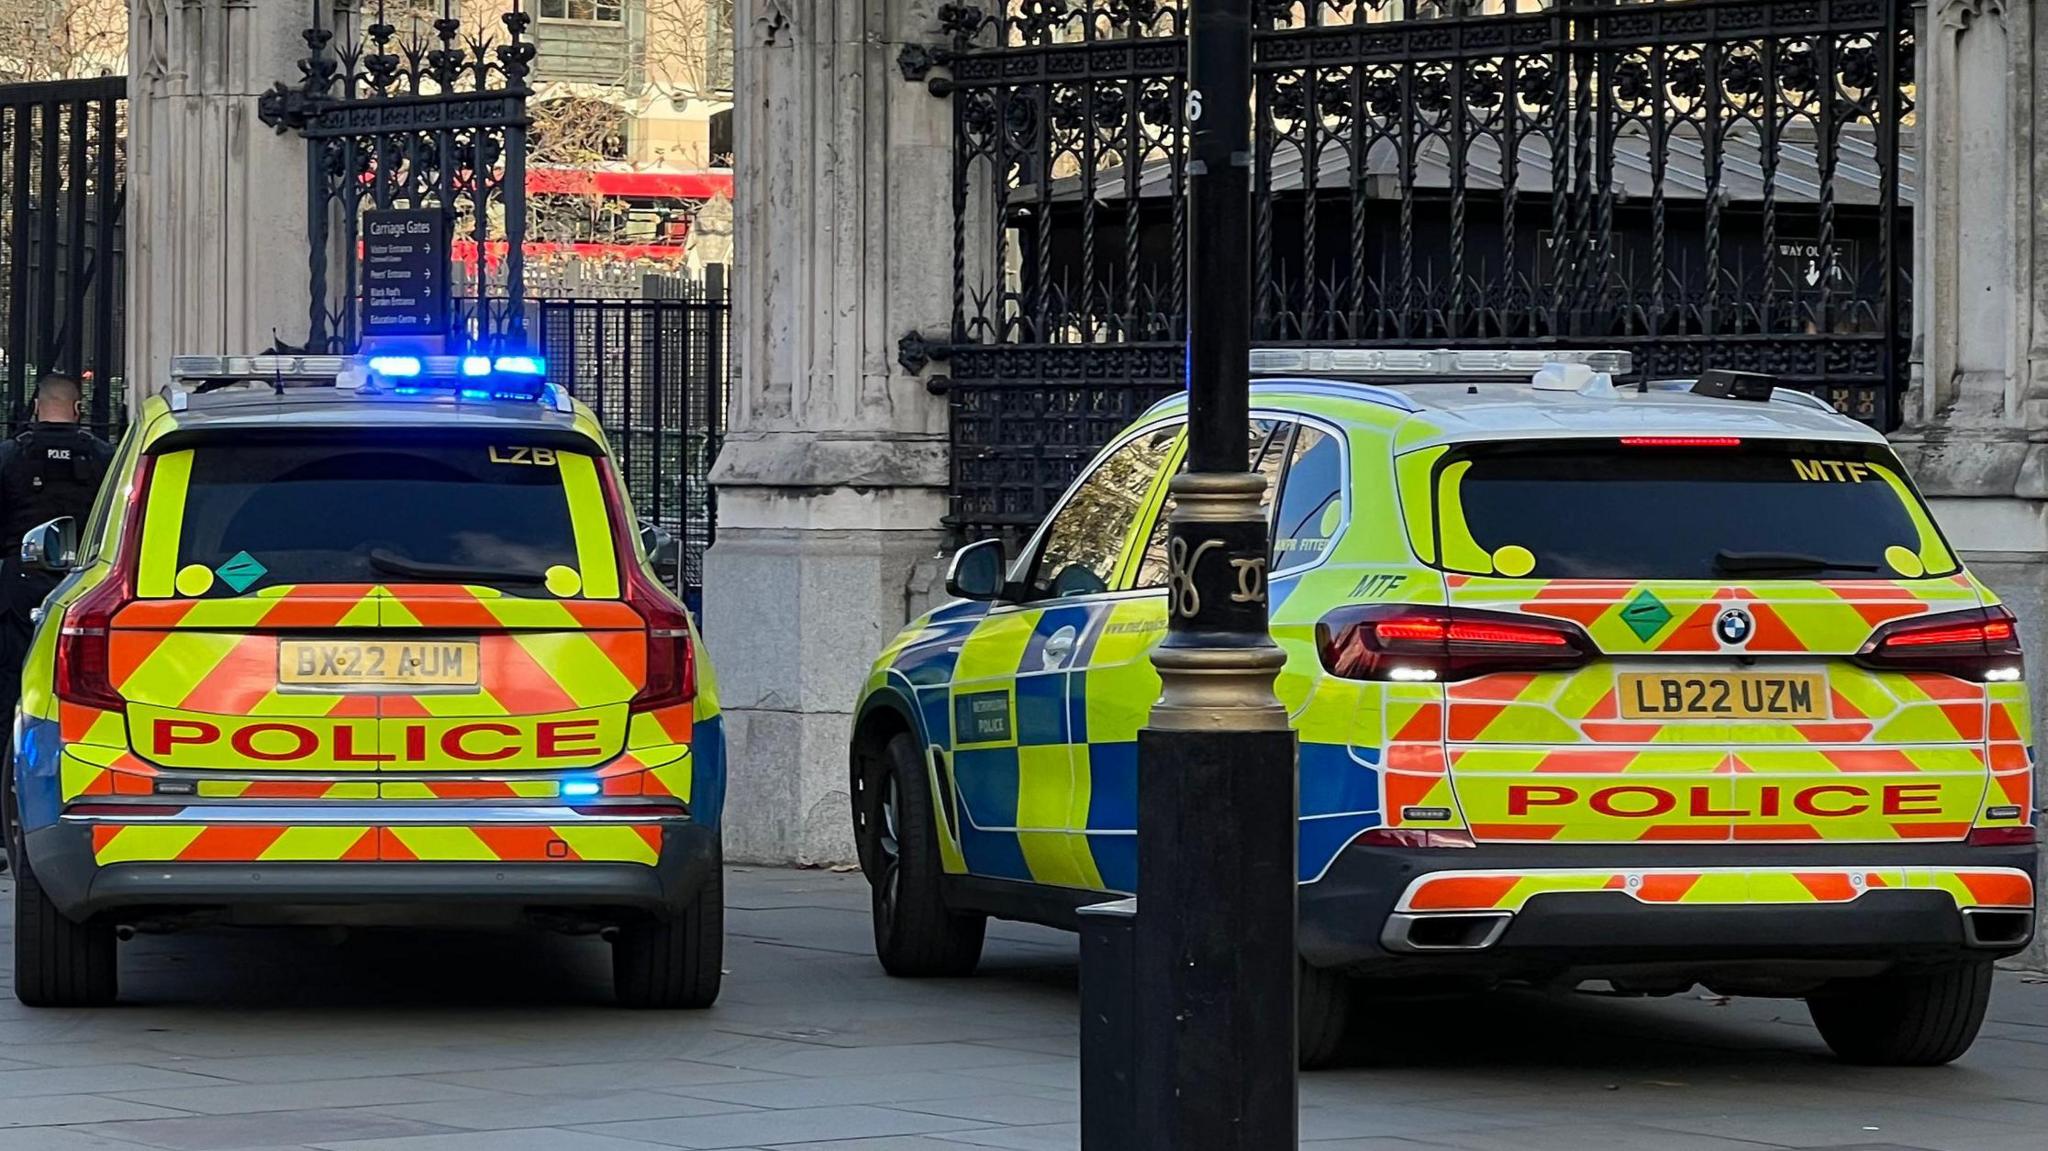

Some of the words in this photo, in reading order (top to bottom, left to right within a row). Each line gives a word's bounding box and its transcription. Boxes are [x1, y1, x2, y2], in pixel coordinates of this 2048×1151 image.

[1185, 90, 1202, 121] 6
[370, 222, 405, 238] Carriage
[406, 220, 430, 234] Gates
[1780, 245, 1803, 256] WAY
[47, 449, 71, 460] POLICE
[488, 445, 557, 466] LZB
[1791, 459, 1868, 483] MTF
[1347, 574, 1408, 598] MTF
[297, 646, 385, 676] BX22
[397, 646, 462, 677] AUM
[1636, 679, 1731, 713] LB22
[1741, 679, 1812, 713] UZM
[153, 719, 602, 762] POLICE
[1507, 784, 1943, 818] POLICE
